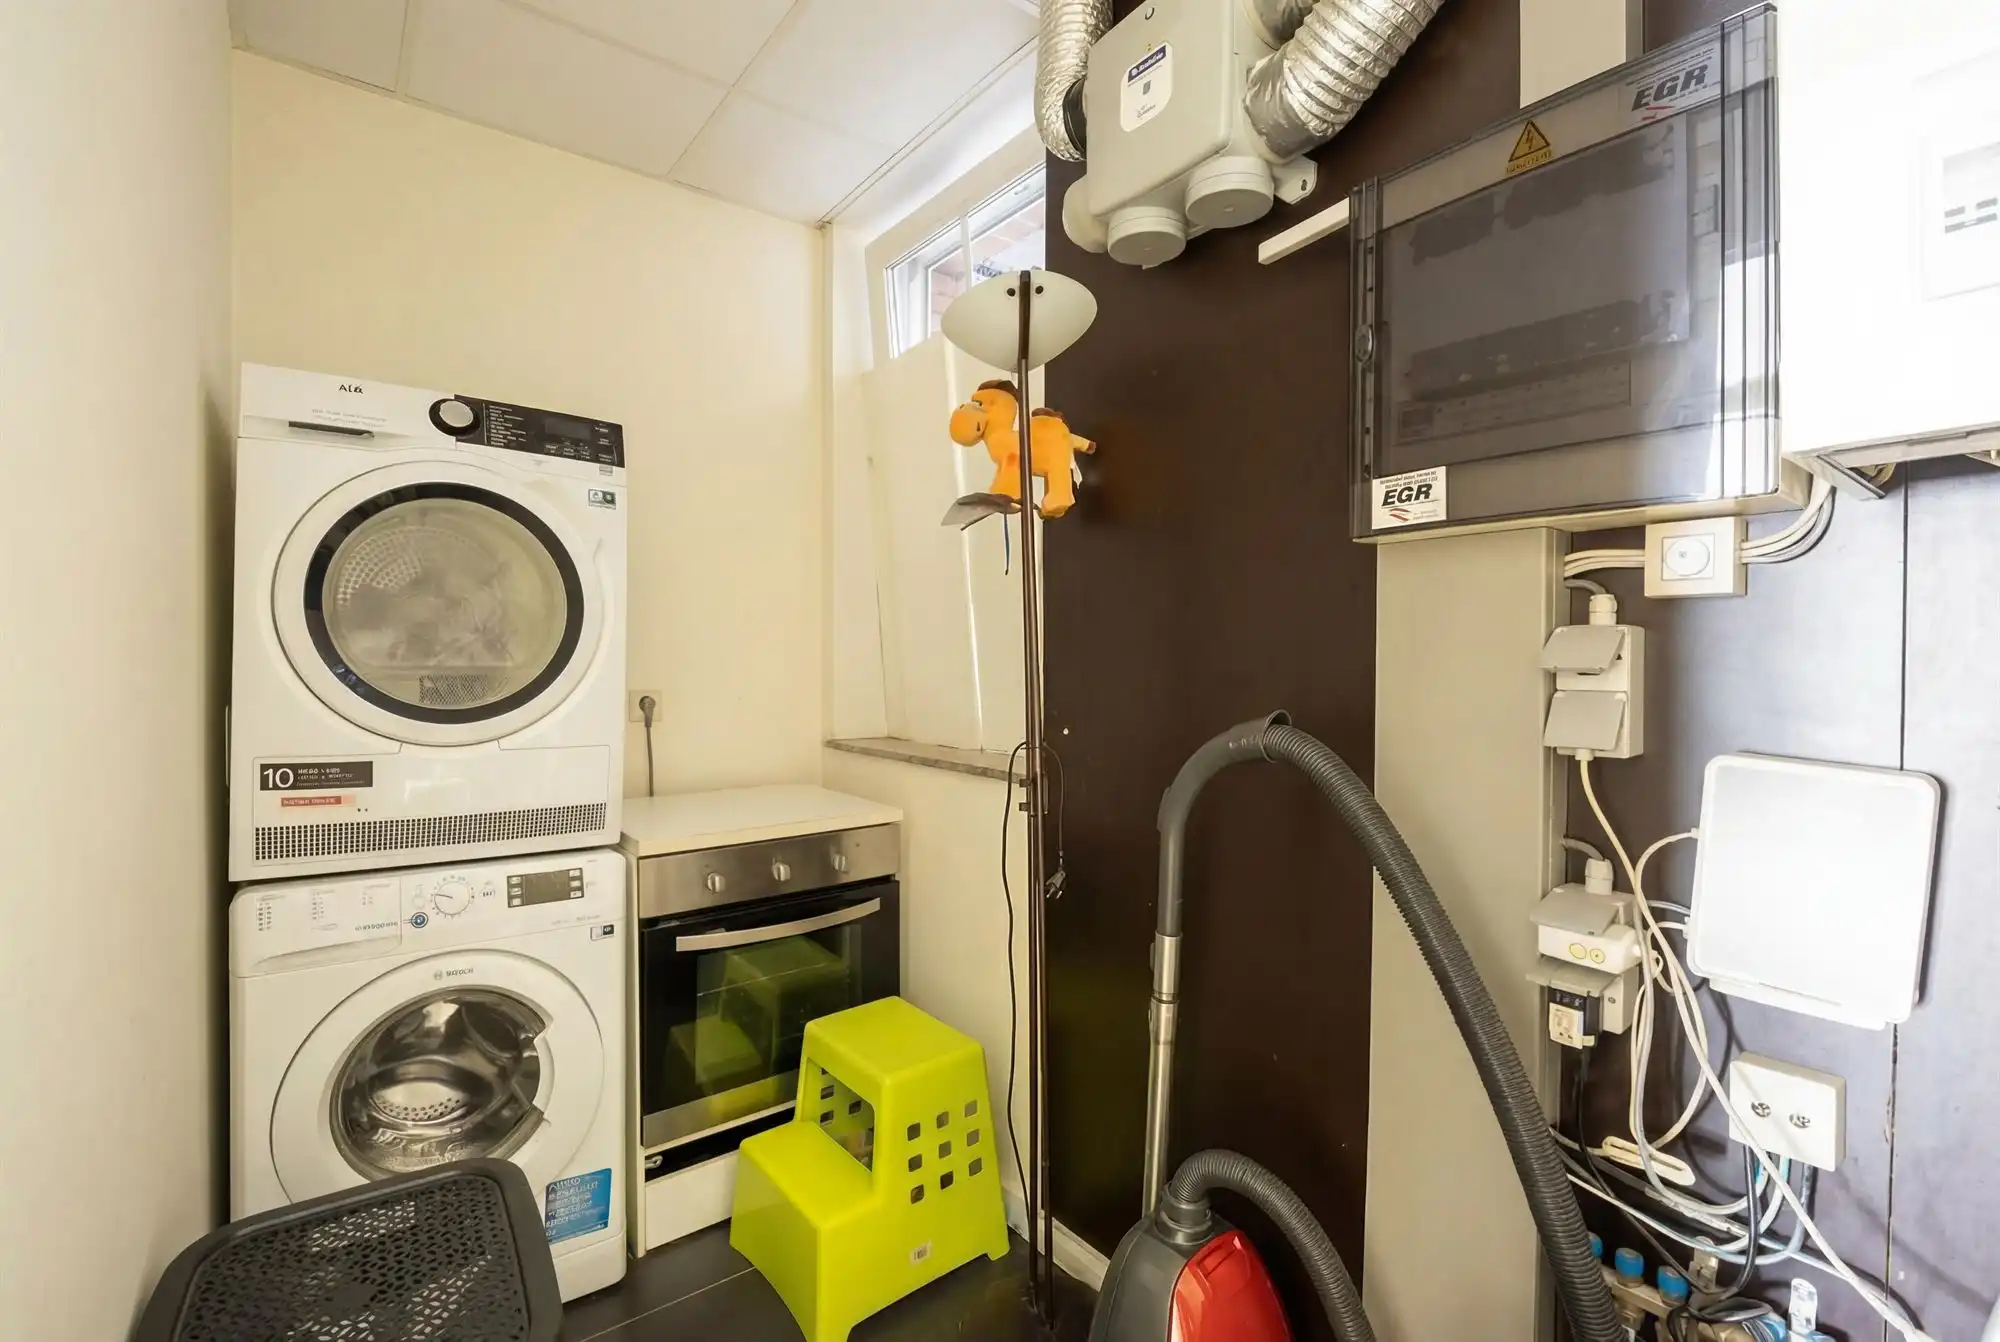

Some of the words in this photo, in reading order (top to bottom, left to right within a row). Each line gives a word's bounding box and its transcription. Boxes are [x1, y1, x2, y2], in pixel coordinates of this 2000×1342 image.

[1631, 64, 1708, 111] EGR
[1382, 484, 1432, 506] EGR
[263, 768, 294, 788] 10
